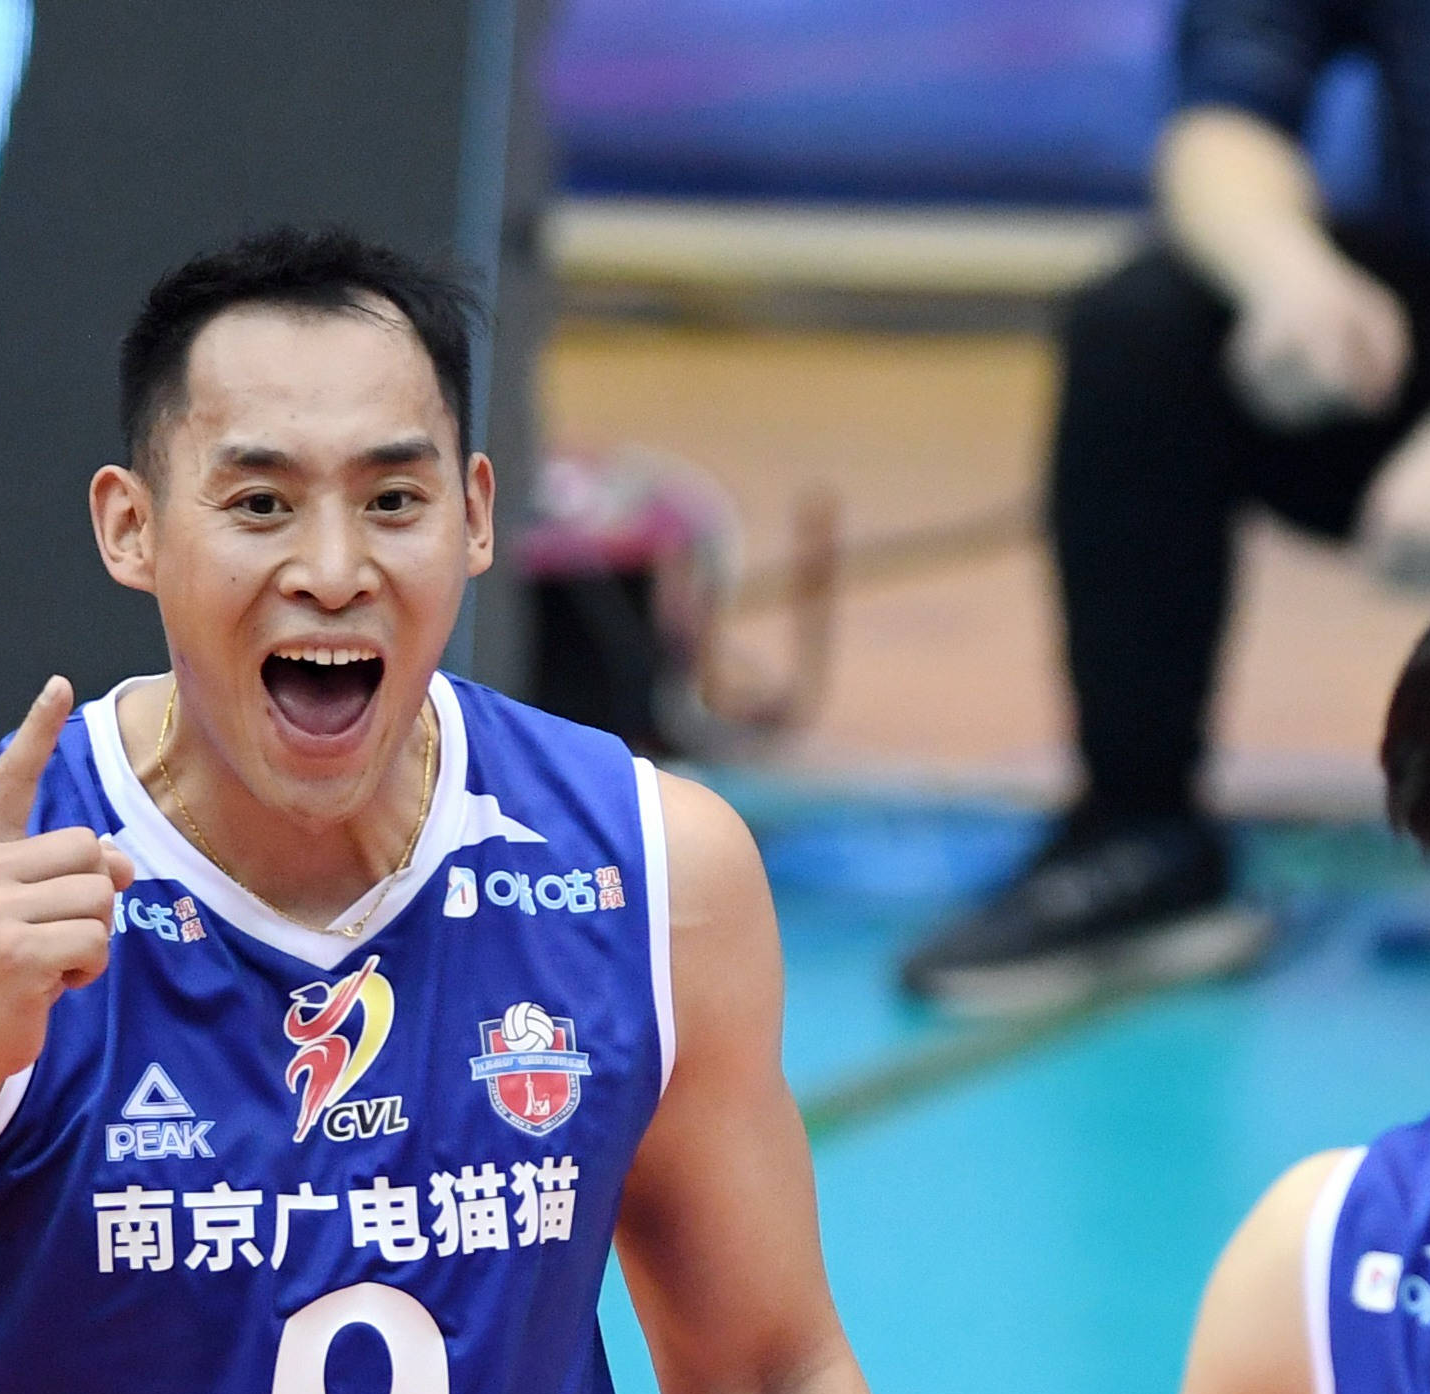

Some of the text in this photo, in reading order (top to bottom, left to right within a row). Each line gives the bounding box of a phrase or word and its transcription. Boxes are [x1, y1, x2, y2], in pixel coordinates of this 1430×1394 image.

[106, 1120, 216, 1162] PEAK
[324, 1095, 409, 1142] CVL
[93, 1156, 580, 1274] 南京广电猫猫
